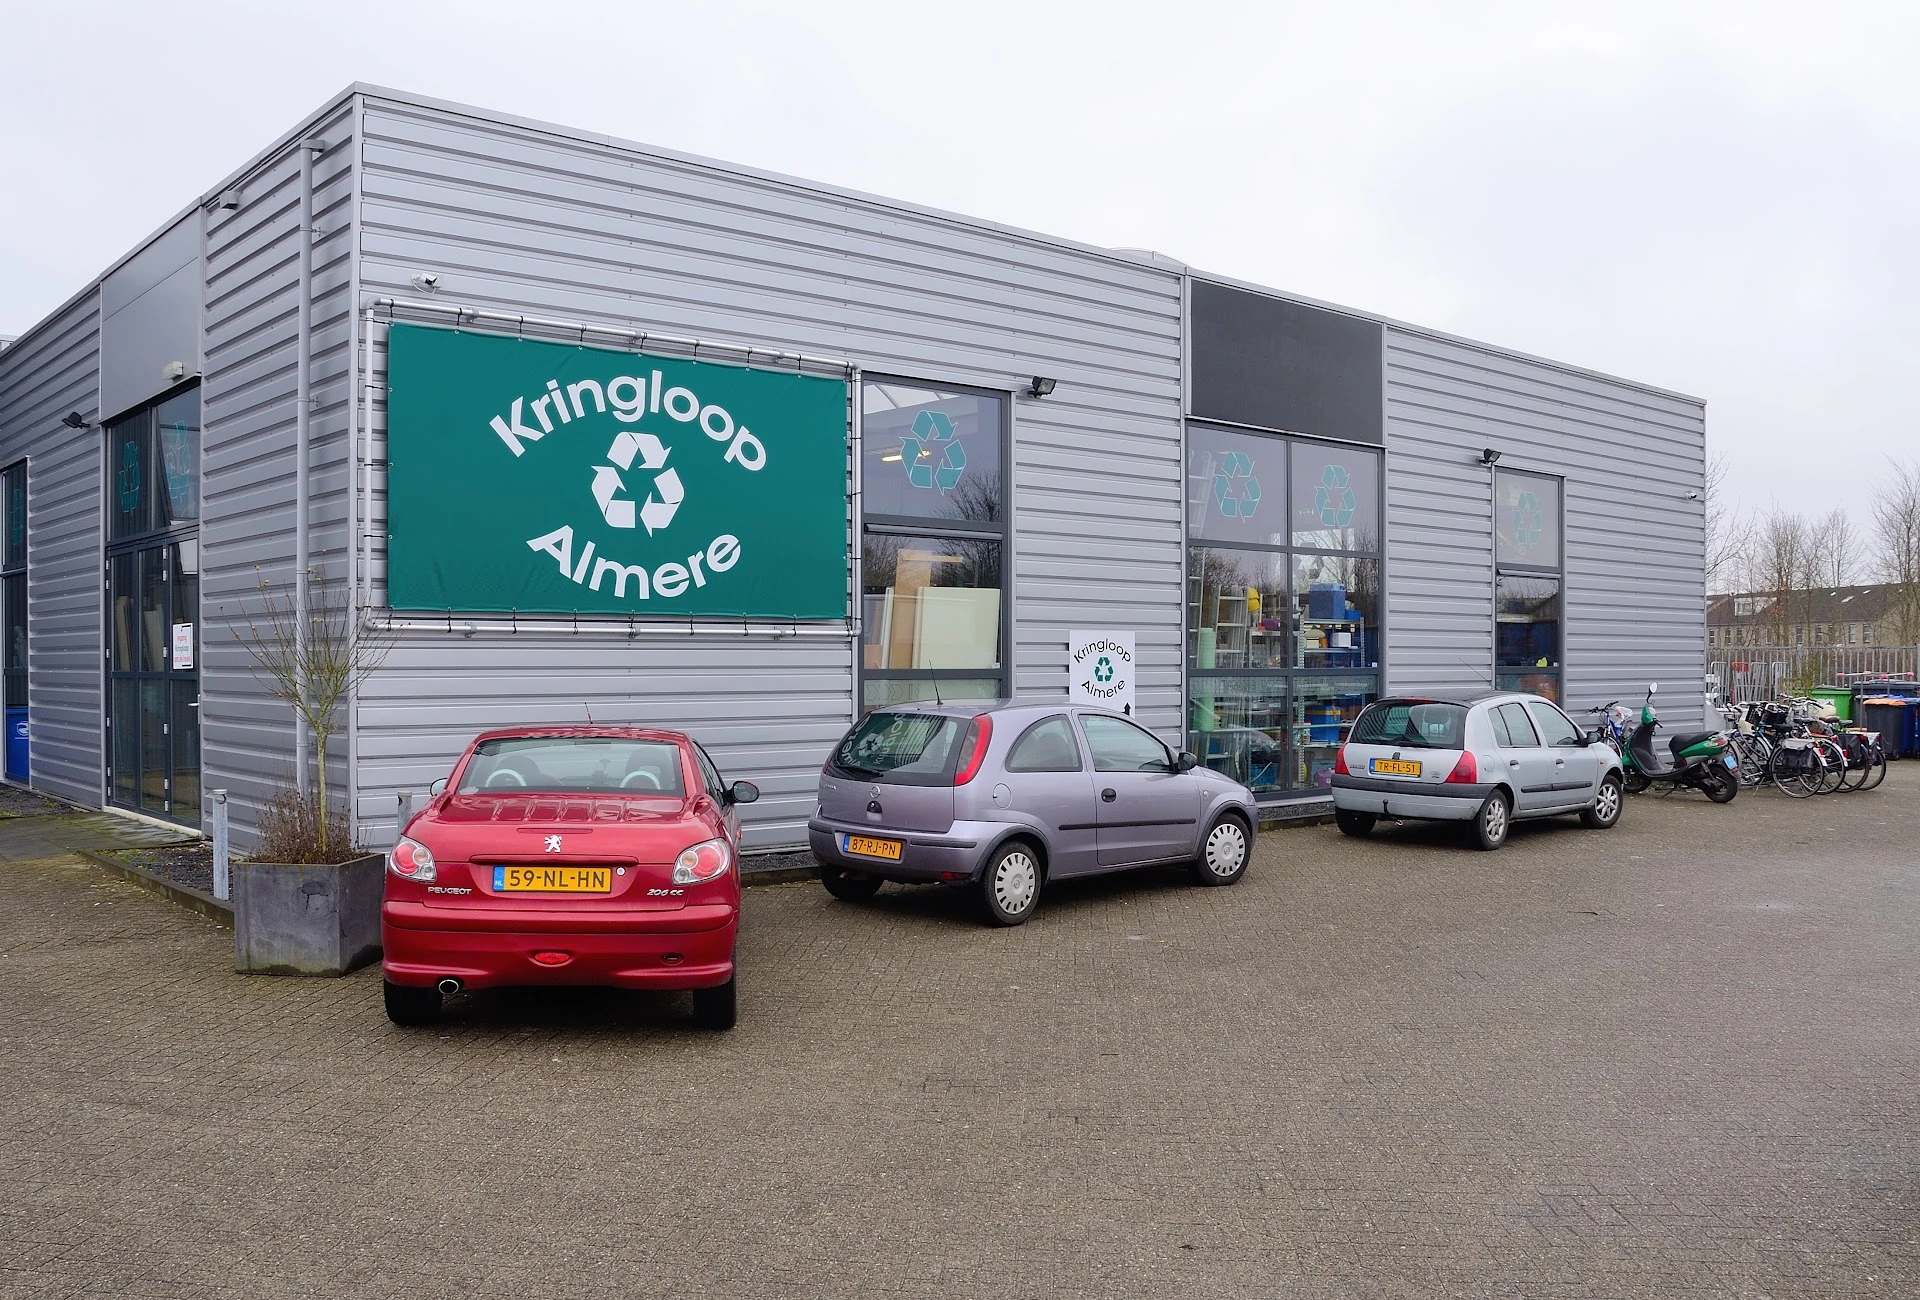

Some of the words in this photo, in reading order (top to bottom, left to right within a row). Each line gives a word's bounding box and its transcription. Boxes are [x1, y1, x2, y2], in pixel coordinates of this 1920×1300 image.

[489, 370, 767, 471] Kringloop
[526, 524, 741, 600] Almere
[1073, 638, 1131, 663] Kringloop
[1081, 680, 1125, 698] Almere
[1378, 761, 1415, 773] TR-FL-51
[852, 838, 896, 856] 87-RJ-PN
[510, 870, 605, 888] 59-NL-HN
[428, 886, 472, 895] PEUGEOT
